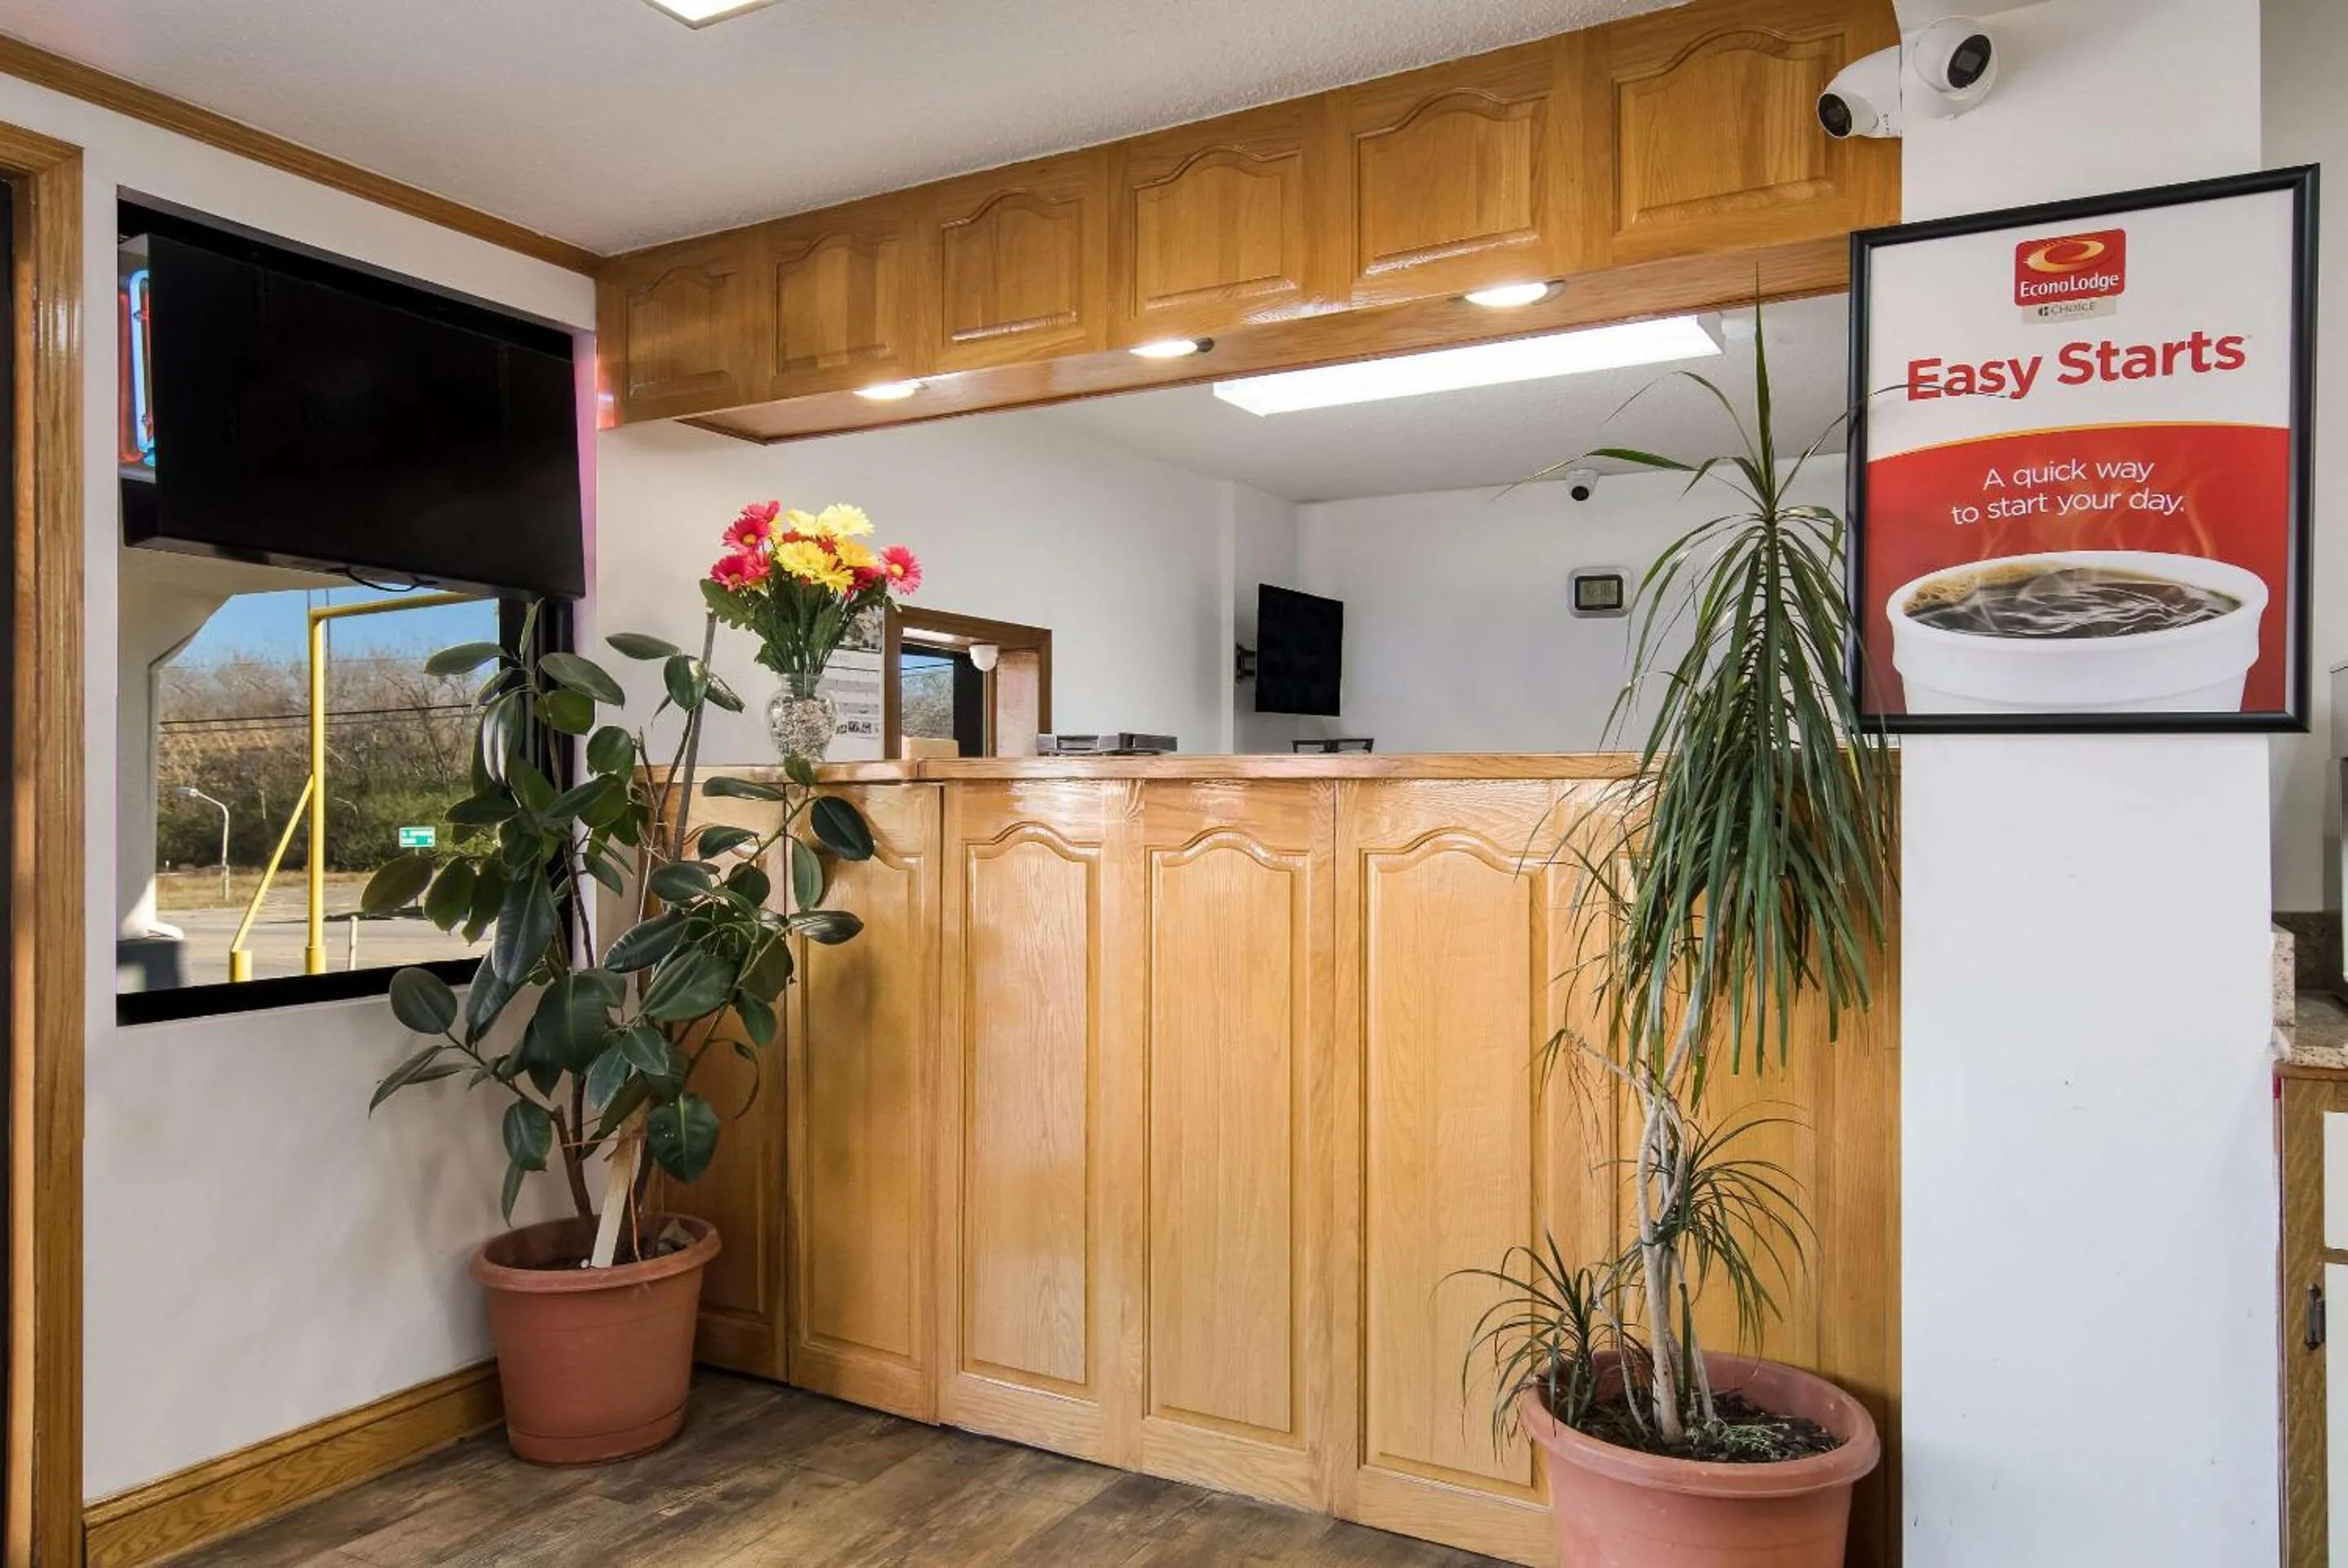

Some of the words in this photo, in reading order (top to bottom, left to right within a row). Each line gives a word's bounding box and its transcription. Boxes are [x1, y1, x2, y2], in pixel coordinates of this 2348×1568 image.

[1907, 356, 2042, 401] Easy
[2056, 330, 2247, 385] Starts
[1983, 468, 2005, 491] A
[2012, 457, 2087, 488] quick
[2095, 462, 2155, 483] way
[1951, 505, 1980, 525] to
[1987, 492, 2049, 519] start
[2056, 490, 2122, 516] your
[2129, 488, 2185, 516] day.
